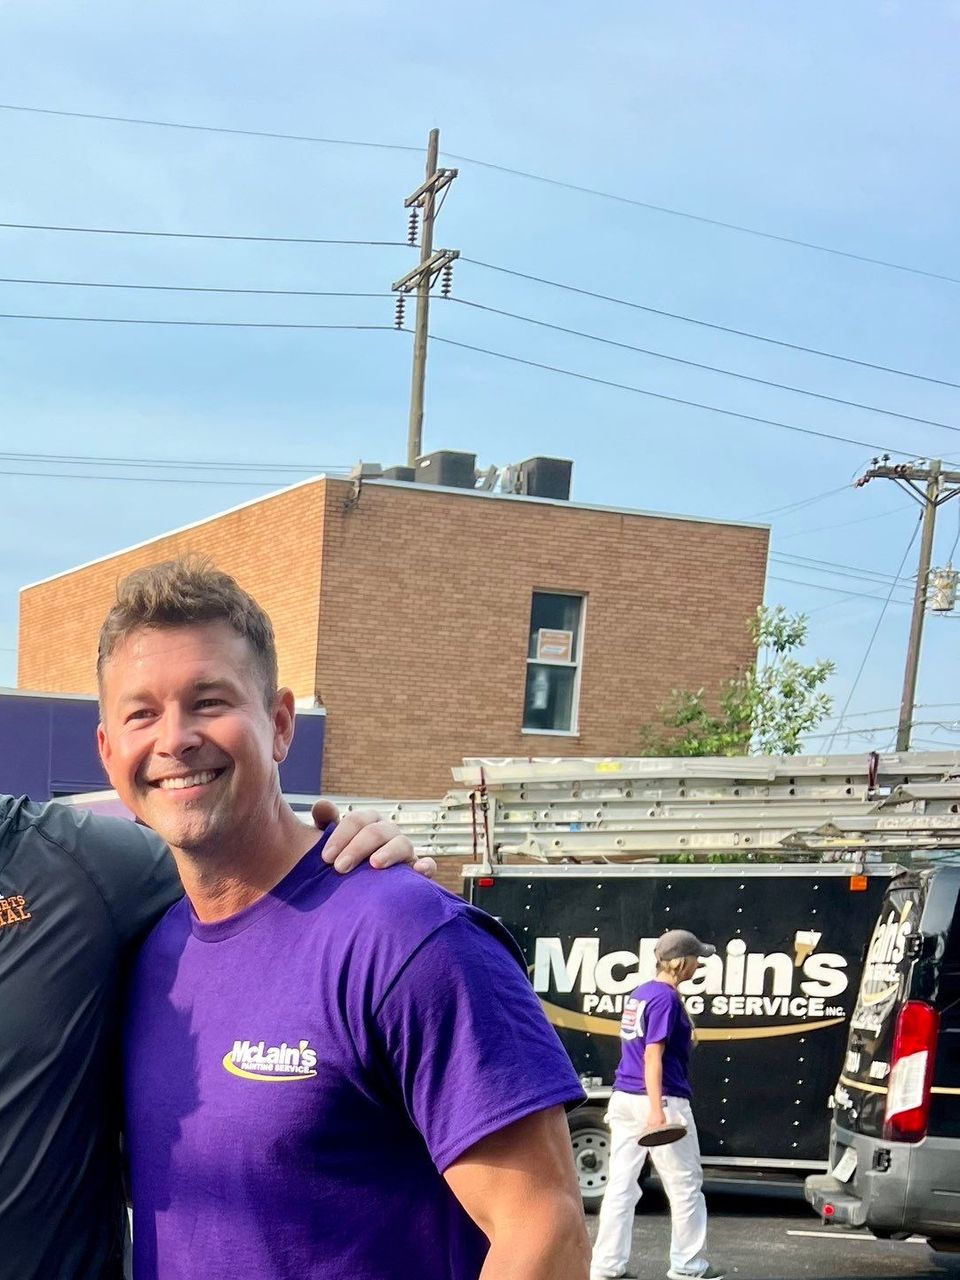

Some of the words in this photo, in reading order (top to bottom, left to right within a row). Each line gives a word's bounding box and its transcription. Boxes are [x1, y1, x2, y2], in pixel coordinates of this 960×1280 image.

[711, 996, 825, 1017] SERVICE
[825, 1006, 846, 1017] INC.
[232, 1040, 317, 1067] McLain's
[274, 1065, 310, 1074] SERVICE
